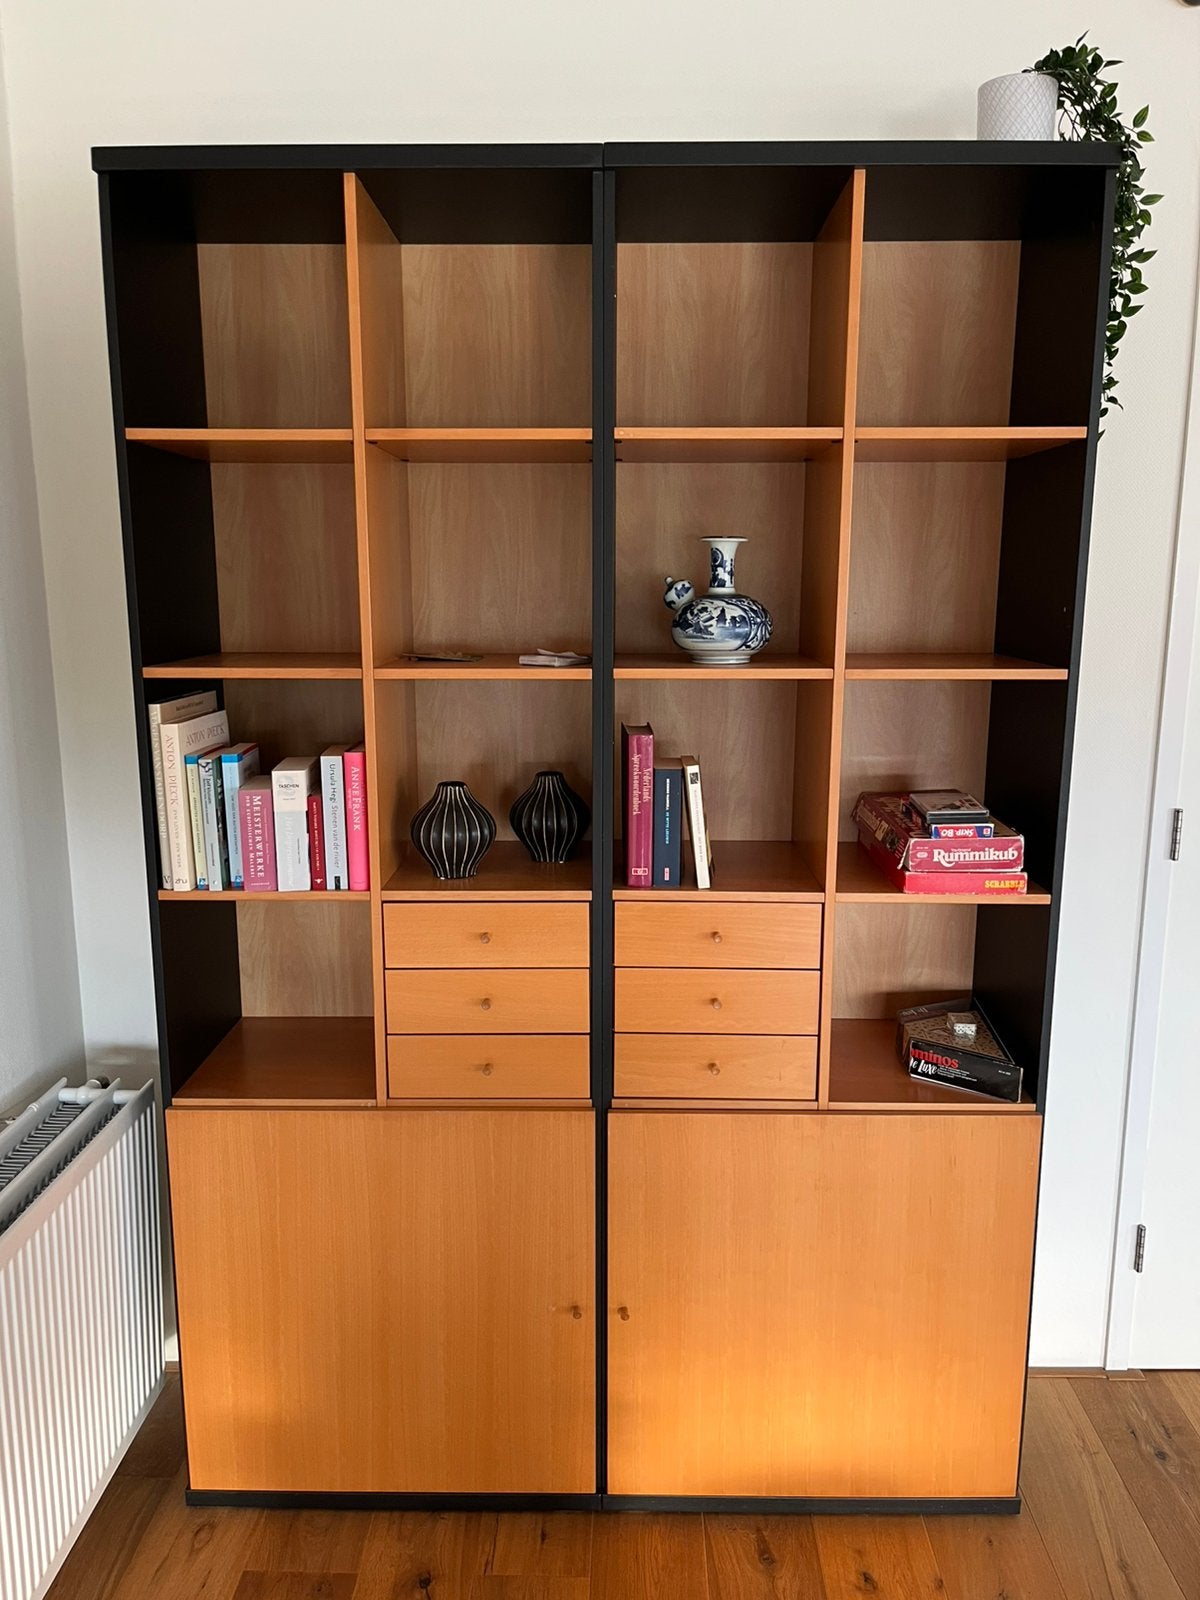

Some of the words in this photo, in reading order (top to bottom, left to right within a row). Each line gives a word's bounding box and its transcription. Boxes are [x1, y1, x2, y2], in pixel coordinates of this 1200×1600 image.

[186, 728, 206, 747] ANTON
[206, 723, 226, 740] PIECK
[165, 734, 178, 770] ANTON
[168, 774, 179, 807] PIECK
[351, 766, 361, 796] ANNE
[632, 753, 642, 816] Spreekwoordenboek
[642, 767, 651, 803] Nederlands
[328, 787, 337, 804] Hegi
[157, 811, 167, 839] DORP
[331, 805, 339, 829] Stenen
[353, 797, 363, 832] FRANK
[252, 795, 265, 878] MEISTERWERKE
[333, 842, 340, 851] de
[333, 851, 341, 869] rivier
[932, 847, 1018, 867] Rummikub
[984, 880, 1025, 889] SCRABBLE
[917, 1059, 938, 1075] Luxe
